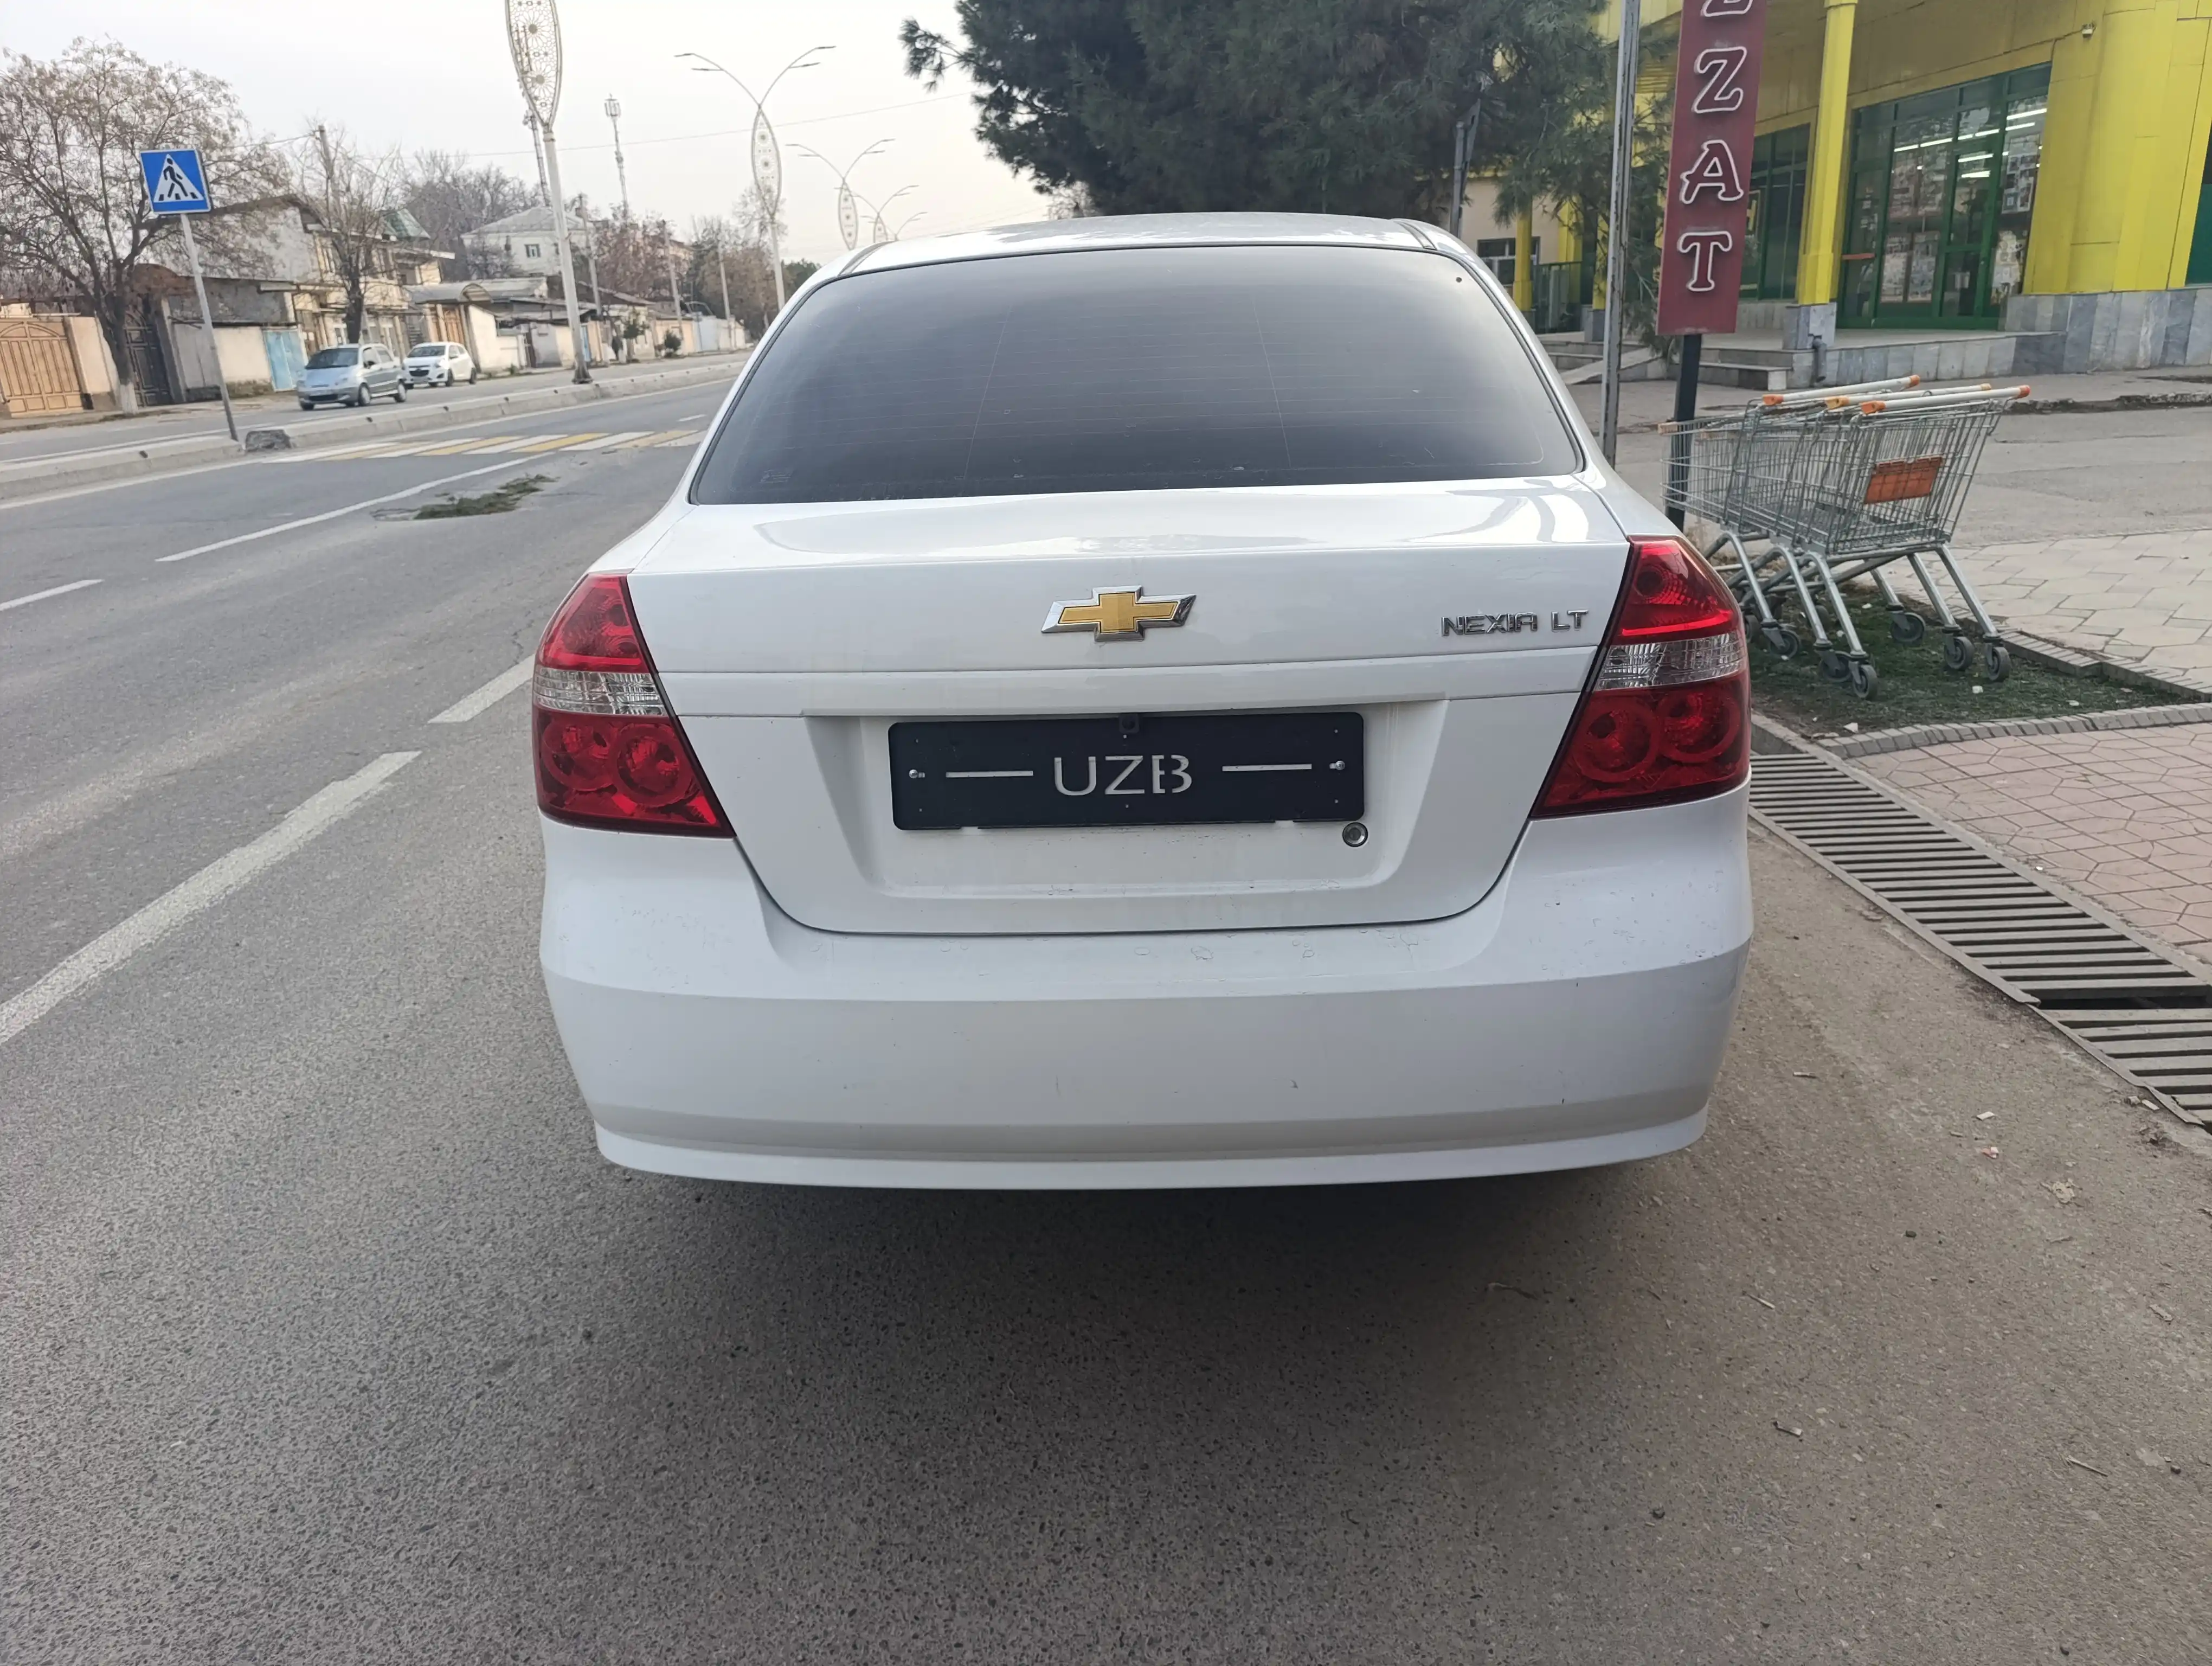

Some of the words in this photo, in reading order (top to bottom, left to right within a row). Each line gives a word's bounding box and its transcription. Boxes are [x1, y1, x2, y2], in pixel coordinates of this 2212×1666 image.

[1677, 0, 1753, 292] ZAT
[1441, 612, 1538, 637] NEXIA
[1551, 609, 1589, 631] LT
[1054, 754, 1193, 796] UZB
